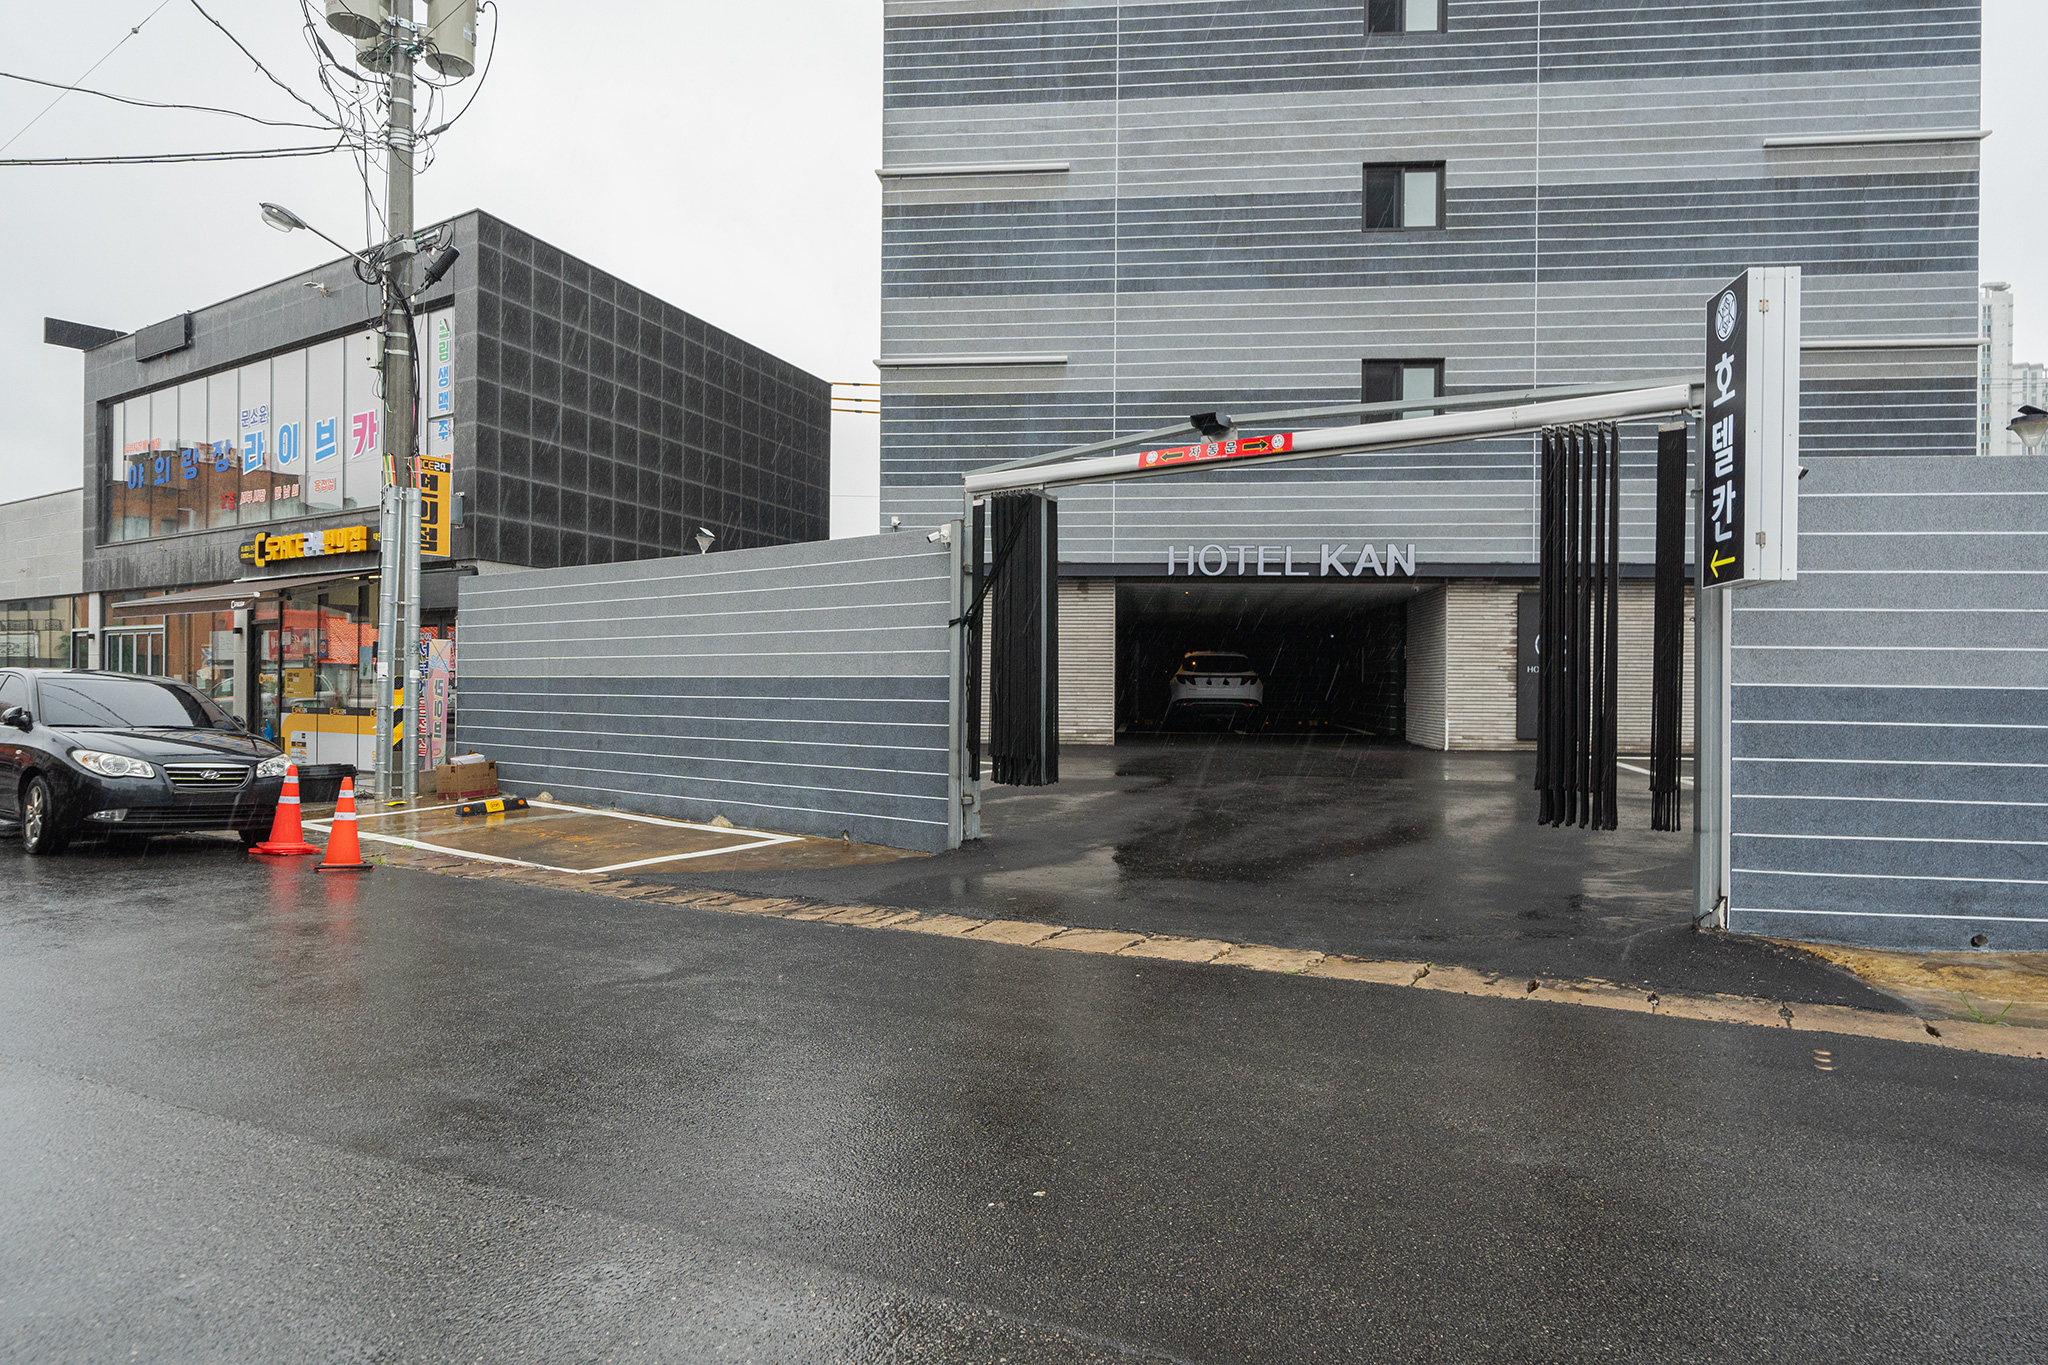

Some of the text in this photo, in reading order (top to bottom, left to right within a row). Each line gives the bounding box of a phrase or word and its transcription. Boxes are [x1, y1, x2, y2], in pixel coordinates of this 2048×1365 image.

[241, 404, 268, 428] 문소윤
[437, 365, 450, 442] 생맥주
[1189, 441, 1237, 457] 자동문
[1711, 352, 1736, 543] 호텔칸
[323, 526, 368, 554] 편의점
[1167, 543, 1416, 577] HOTEL KAN
